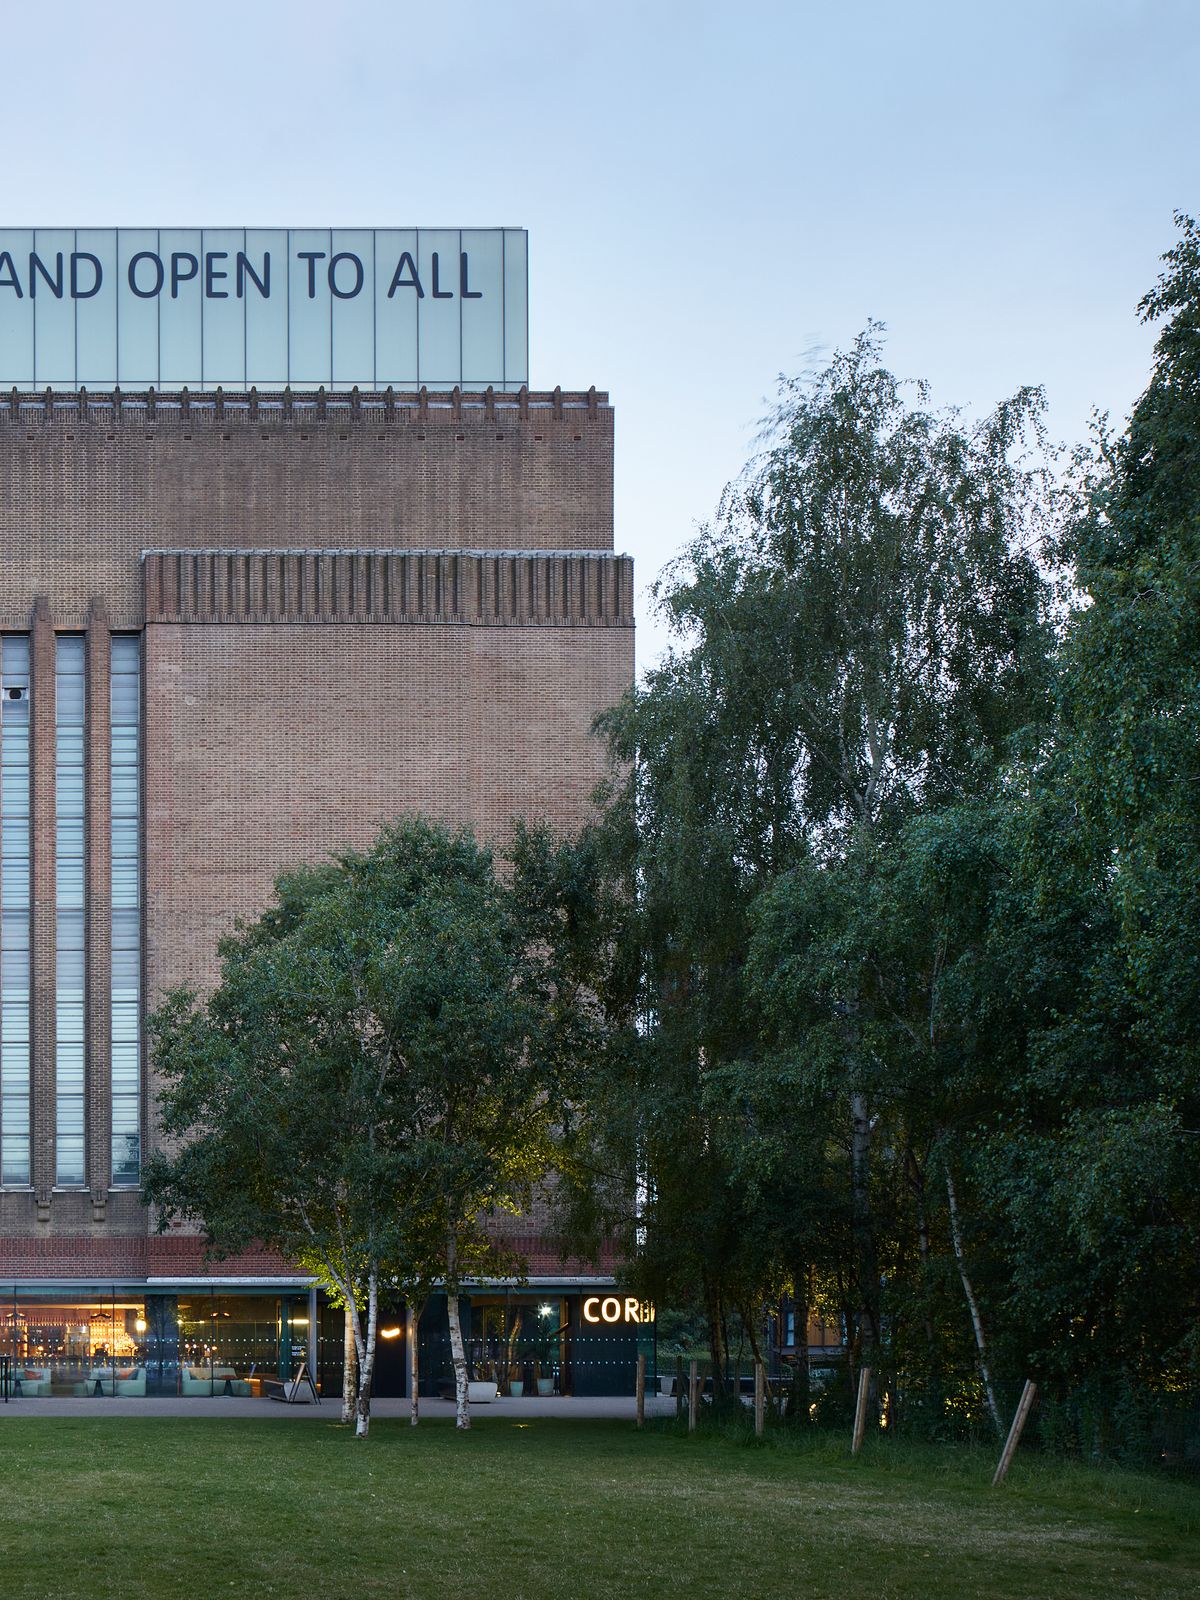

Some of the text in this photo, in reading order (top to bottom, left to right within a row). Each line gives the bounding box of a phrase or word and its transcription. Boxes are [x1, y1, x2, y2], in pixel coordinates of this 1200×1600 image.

[128, 252, 271, 299] OPEN
[297, 252, 365, 299] TO
[388, 252, 483, 298] ALL
